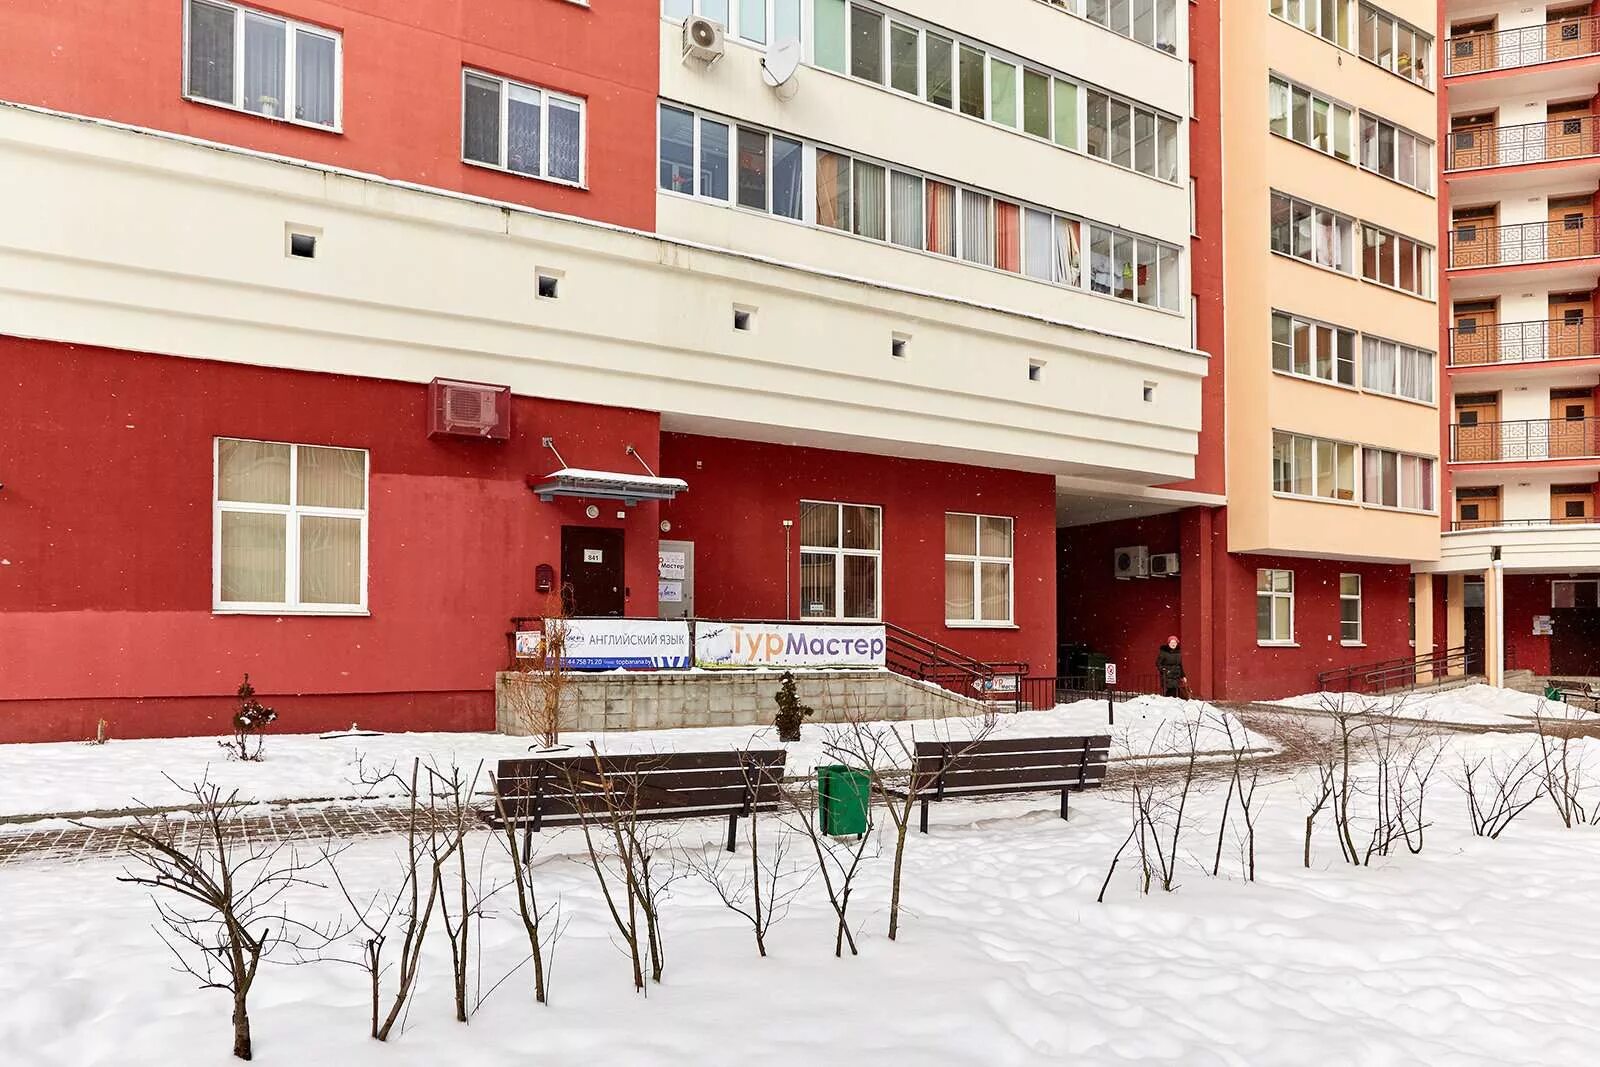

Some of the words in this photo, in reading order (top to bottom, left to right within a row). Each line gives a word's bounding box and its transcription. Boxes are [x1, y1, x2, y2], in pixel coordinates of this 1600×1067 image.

[589, 632, 657, 646] АНГЛИЙСКИЙ
[660, 634, 684, 646] ЯЗЫК
[730, 625, 884, 662] ТурМастер
[615, 659, 651, 667] topbanana.by
